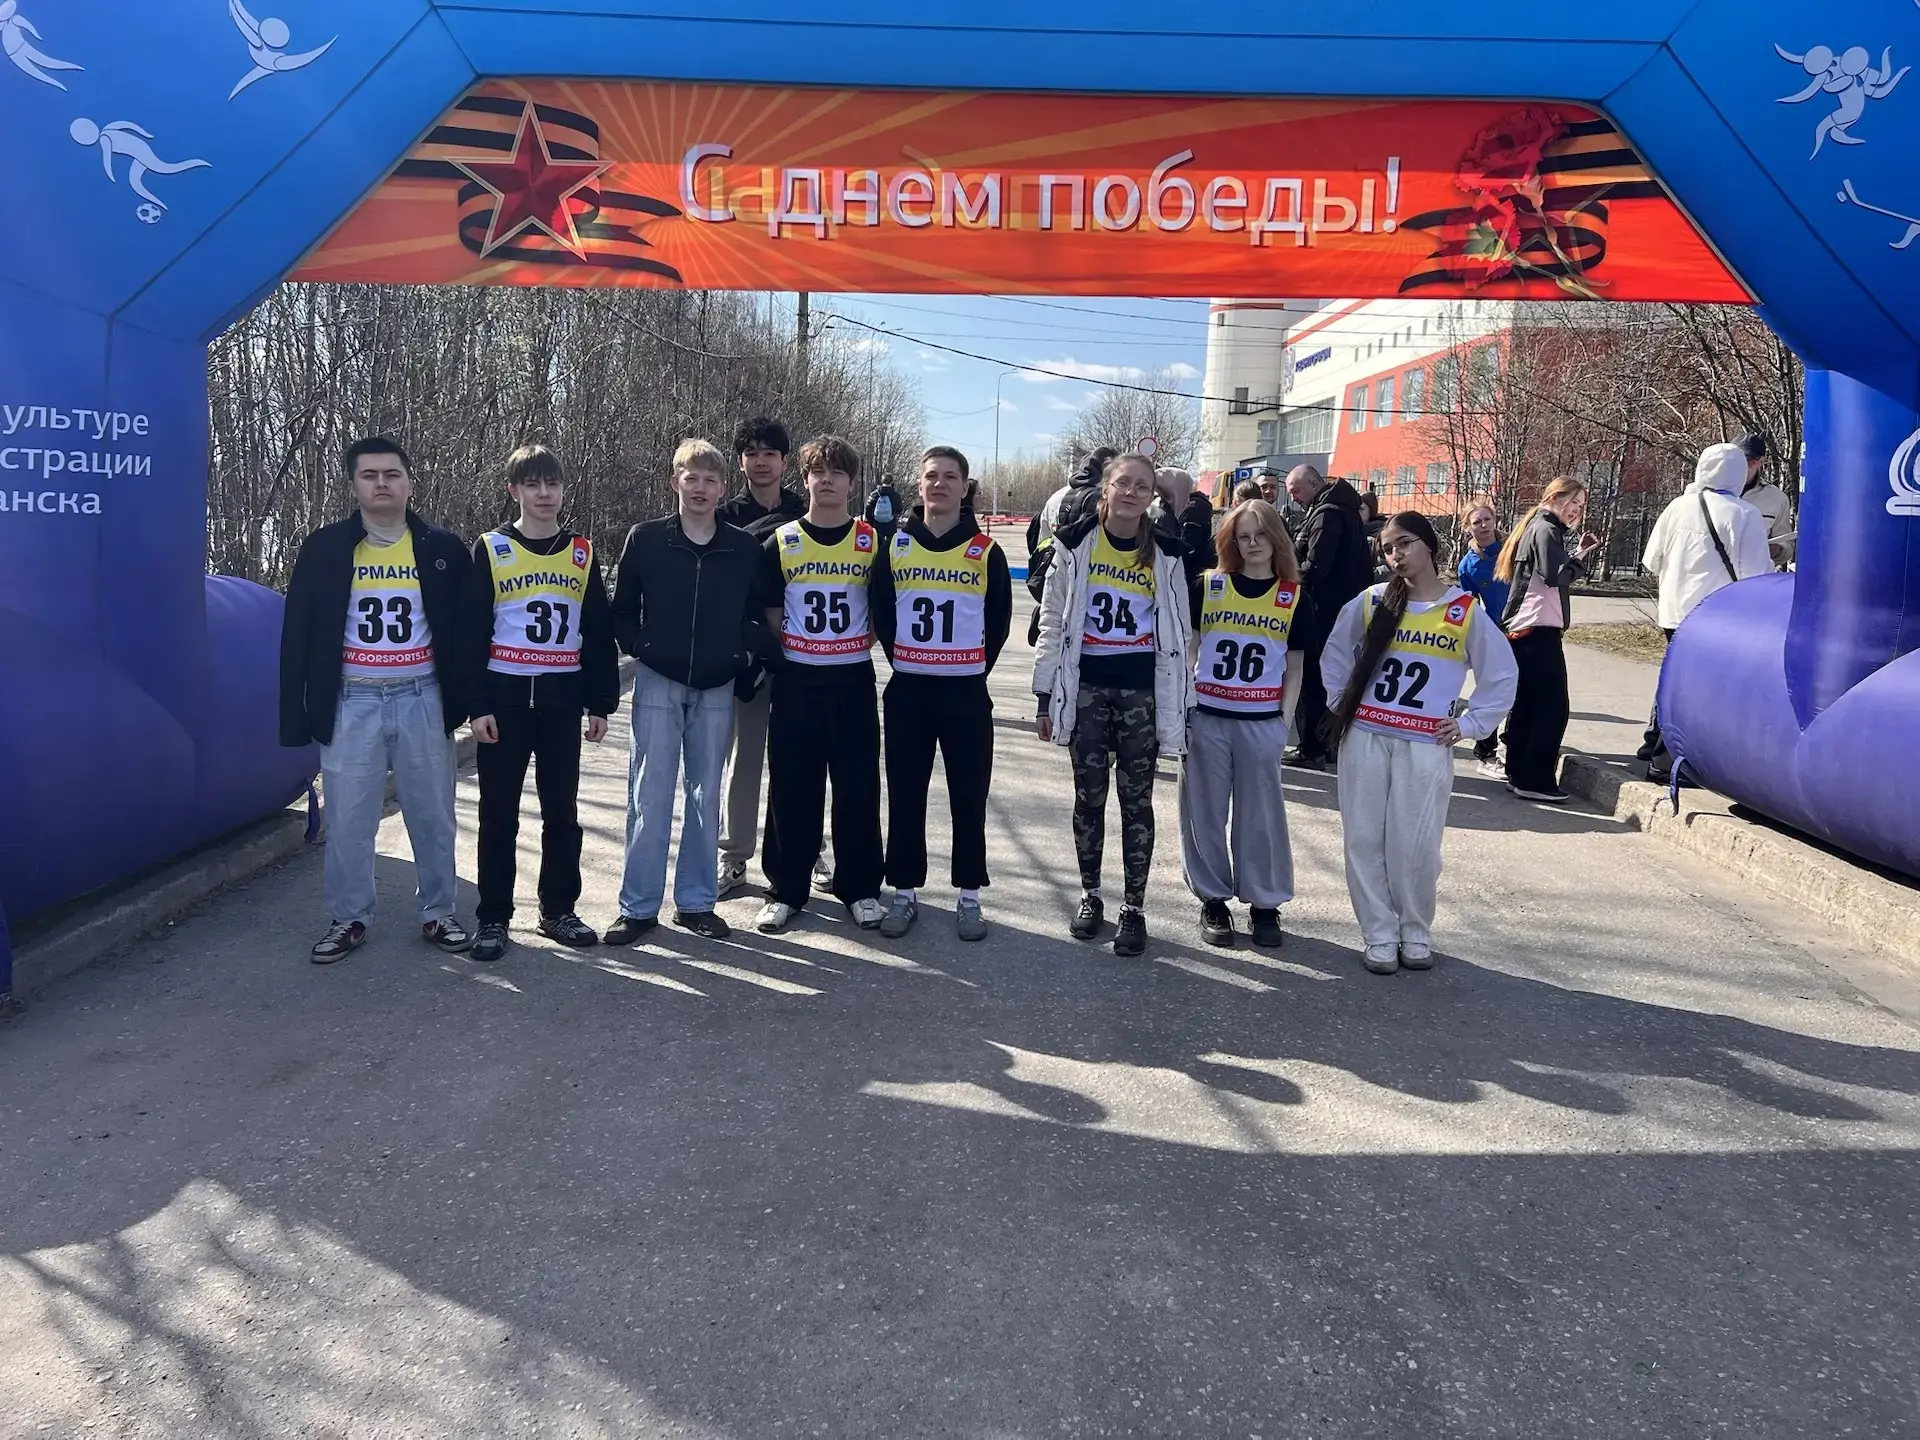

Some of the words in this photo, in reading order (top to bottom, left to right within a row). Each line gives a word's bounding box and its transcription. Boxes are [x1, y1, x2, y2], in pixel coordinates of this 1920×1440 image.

[680, 142, 734, 223] С
[1038, 148, 1402, 247] победы!
[0, 404, 149, 440] ультуре
[0, 447, 151, 479] страции
[352, 565, 419, 581] РМАНС
[787, 562, 871, 580] МУРМАНСК
[892, 567, 981, 586] МУРМАНСК
[358, 596, 412, 644] 33
[525, 600, 570, 645] 37
[804, 590, 850, 634] 35
[911, 597, 955, 643] 31
[1092, 591, 1139, 637] 34
[1203, 610, 1288, 634] МУРМАНСК
[1212, 639, 1266, 683] 36
[1394, 628, 1459, 652] МАНСК
[1374, 657, 1430, 710] 32
